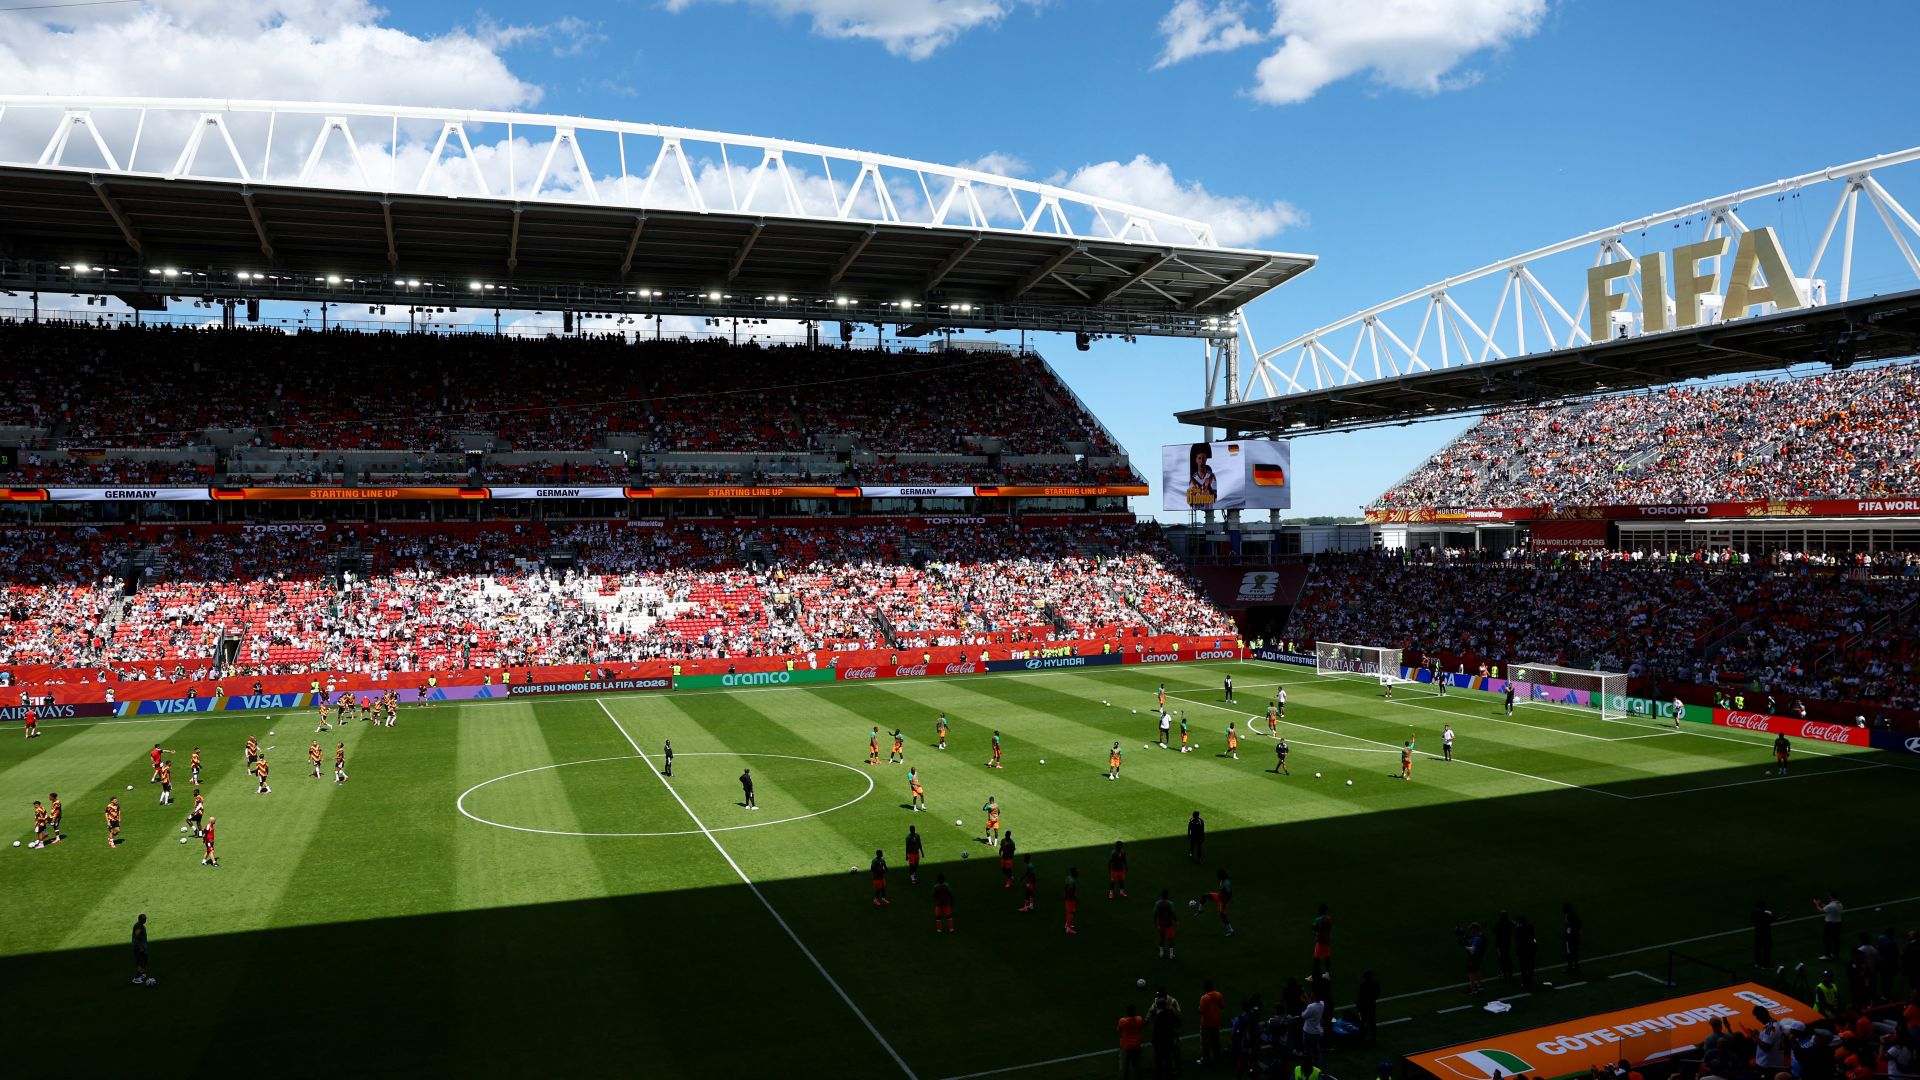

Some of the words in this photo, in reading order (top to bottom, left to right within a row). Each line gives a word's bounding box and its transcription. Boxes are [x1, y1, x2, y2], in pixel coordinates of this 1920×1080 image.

[1587, 227, 1801, 341] FIFA
[104, 490, 157, 499] GERMANY
[310, 490, 359, 498] STARTING
[361, 490, 383, 498] LINE
[385, 490, 398, 498] UP
[536, 489, 580, 497] GERMANY
[1639, 505, 1708, 515] TORONTO
[1858, 501, 1883, 511] FIFA
[1141, 653, 1178, 663] Lenovo
[1195, 650, 1234, 660] Lenovo
[1262, 651, 1276, 660] ADI
[1276, 653, 1317, 665] PREDICTSTREE
[945, 662, 976, 674] Coca-Cola
[1044, 657, 1084, 667] HYUNDAI
[1326, 658, 1355, 672] QATAR
[844, 667, 877, 679] Coca-Cola
[896, 664, 927, 677] Coca-Cola
[722, 671, 790, 686] aramco
[512, 685, 542, 694] COUPE
[543, 684, 556, 692] DU
[557, 683, 588, 691] MONDE
[590, 682, 601, 690] DE
[615, 681, 634, 689] FIFA
[636, 680, 665, 688] 2026
[152, 698, 198, 714] VISA
[240, 694, 283, 709] VISA
[1726, 711, 1771, 731] Coca-Cola
[1801, 721, 1852, 743] Coca-Cola
[1535, 1028, 1625, 1056] CÔTE
[1612, 1003, 1741, 1038] D'IVOIRE
